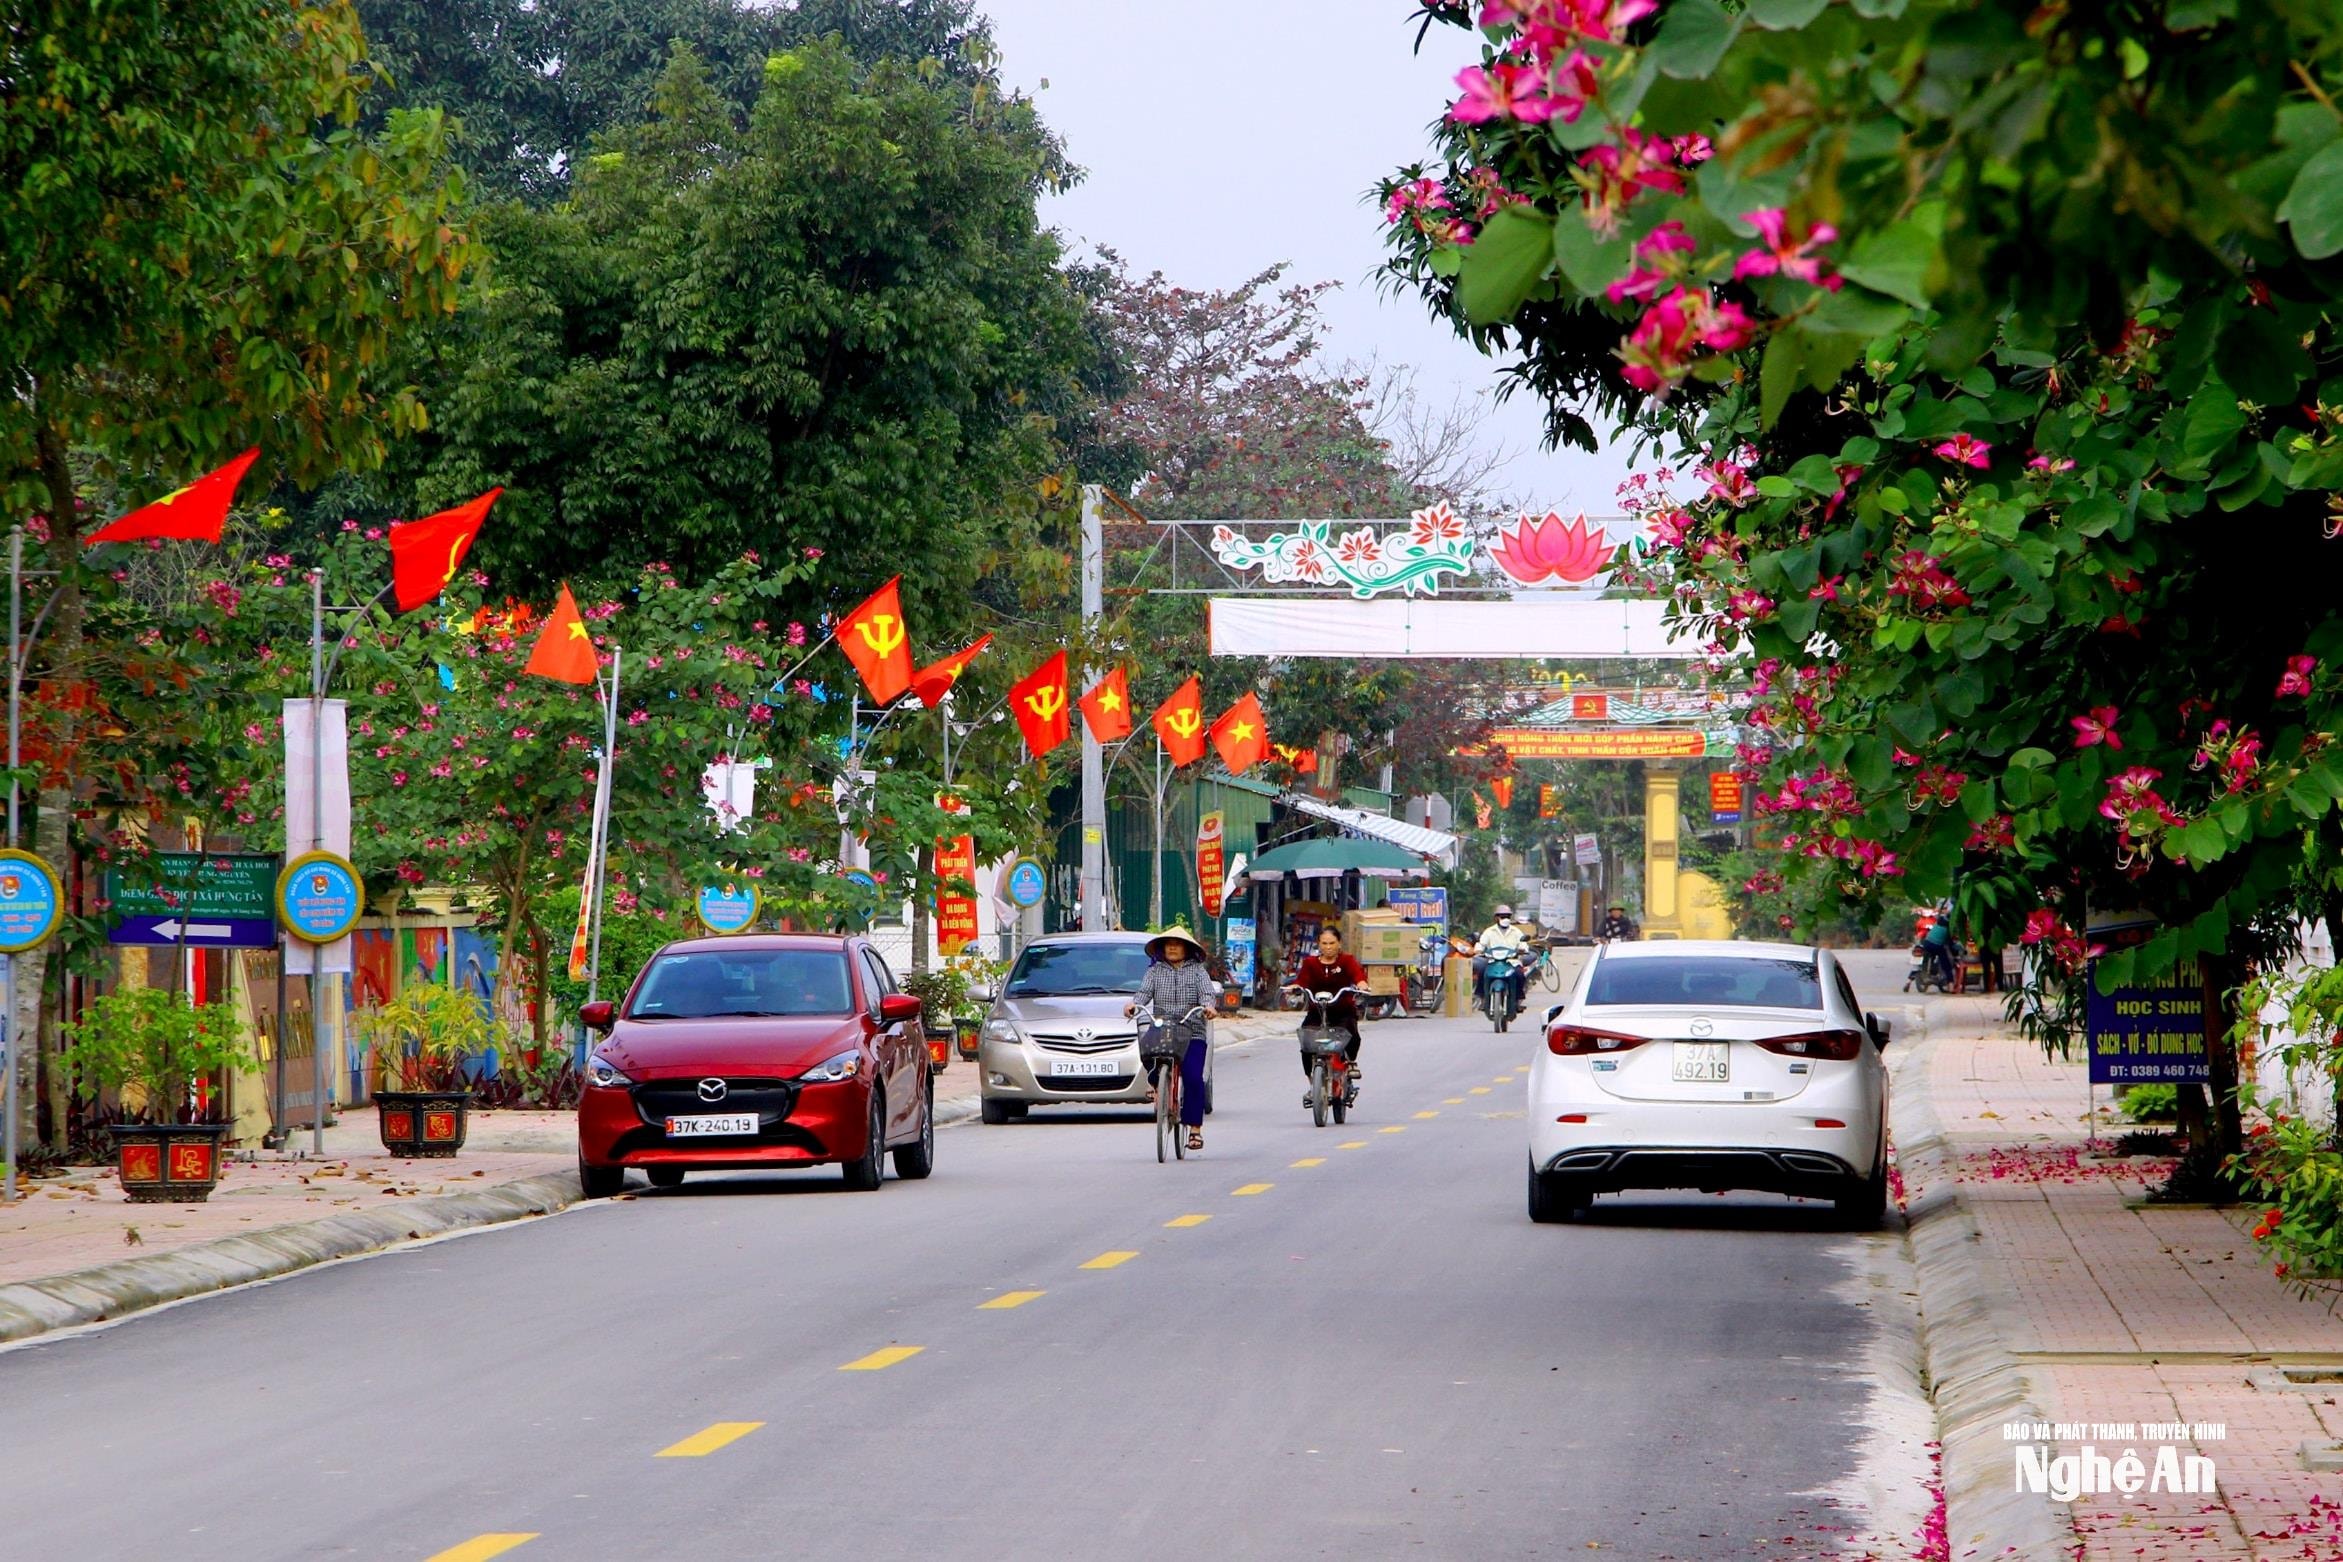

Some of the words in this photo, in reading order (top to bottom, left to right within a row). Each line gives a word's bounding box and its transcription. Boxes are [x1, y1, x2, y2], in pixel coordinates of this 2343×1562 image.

[1541, 881, 1577, 891] Coffee
[2116, 1000, 2152, 1018] HỌC
[2158, 1000, 2201, 1015] SINH
[2186, 1033, 2205, 1059] HỌC
[1674, 1062, 1728, 1079] 492.19
[2109, 1064, 2129, 1077] ĐT:
[2131, 1064, 2161, 1077] 0389
[2163, 1064, 2186, 1077] 460
[2188, 1064, 2211, 1077] 748
[674, 1118, 751, 1134] 37K-240.19
